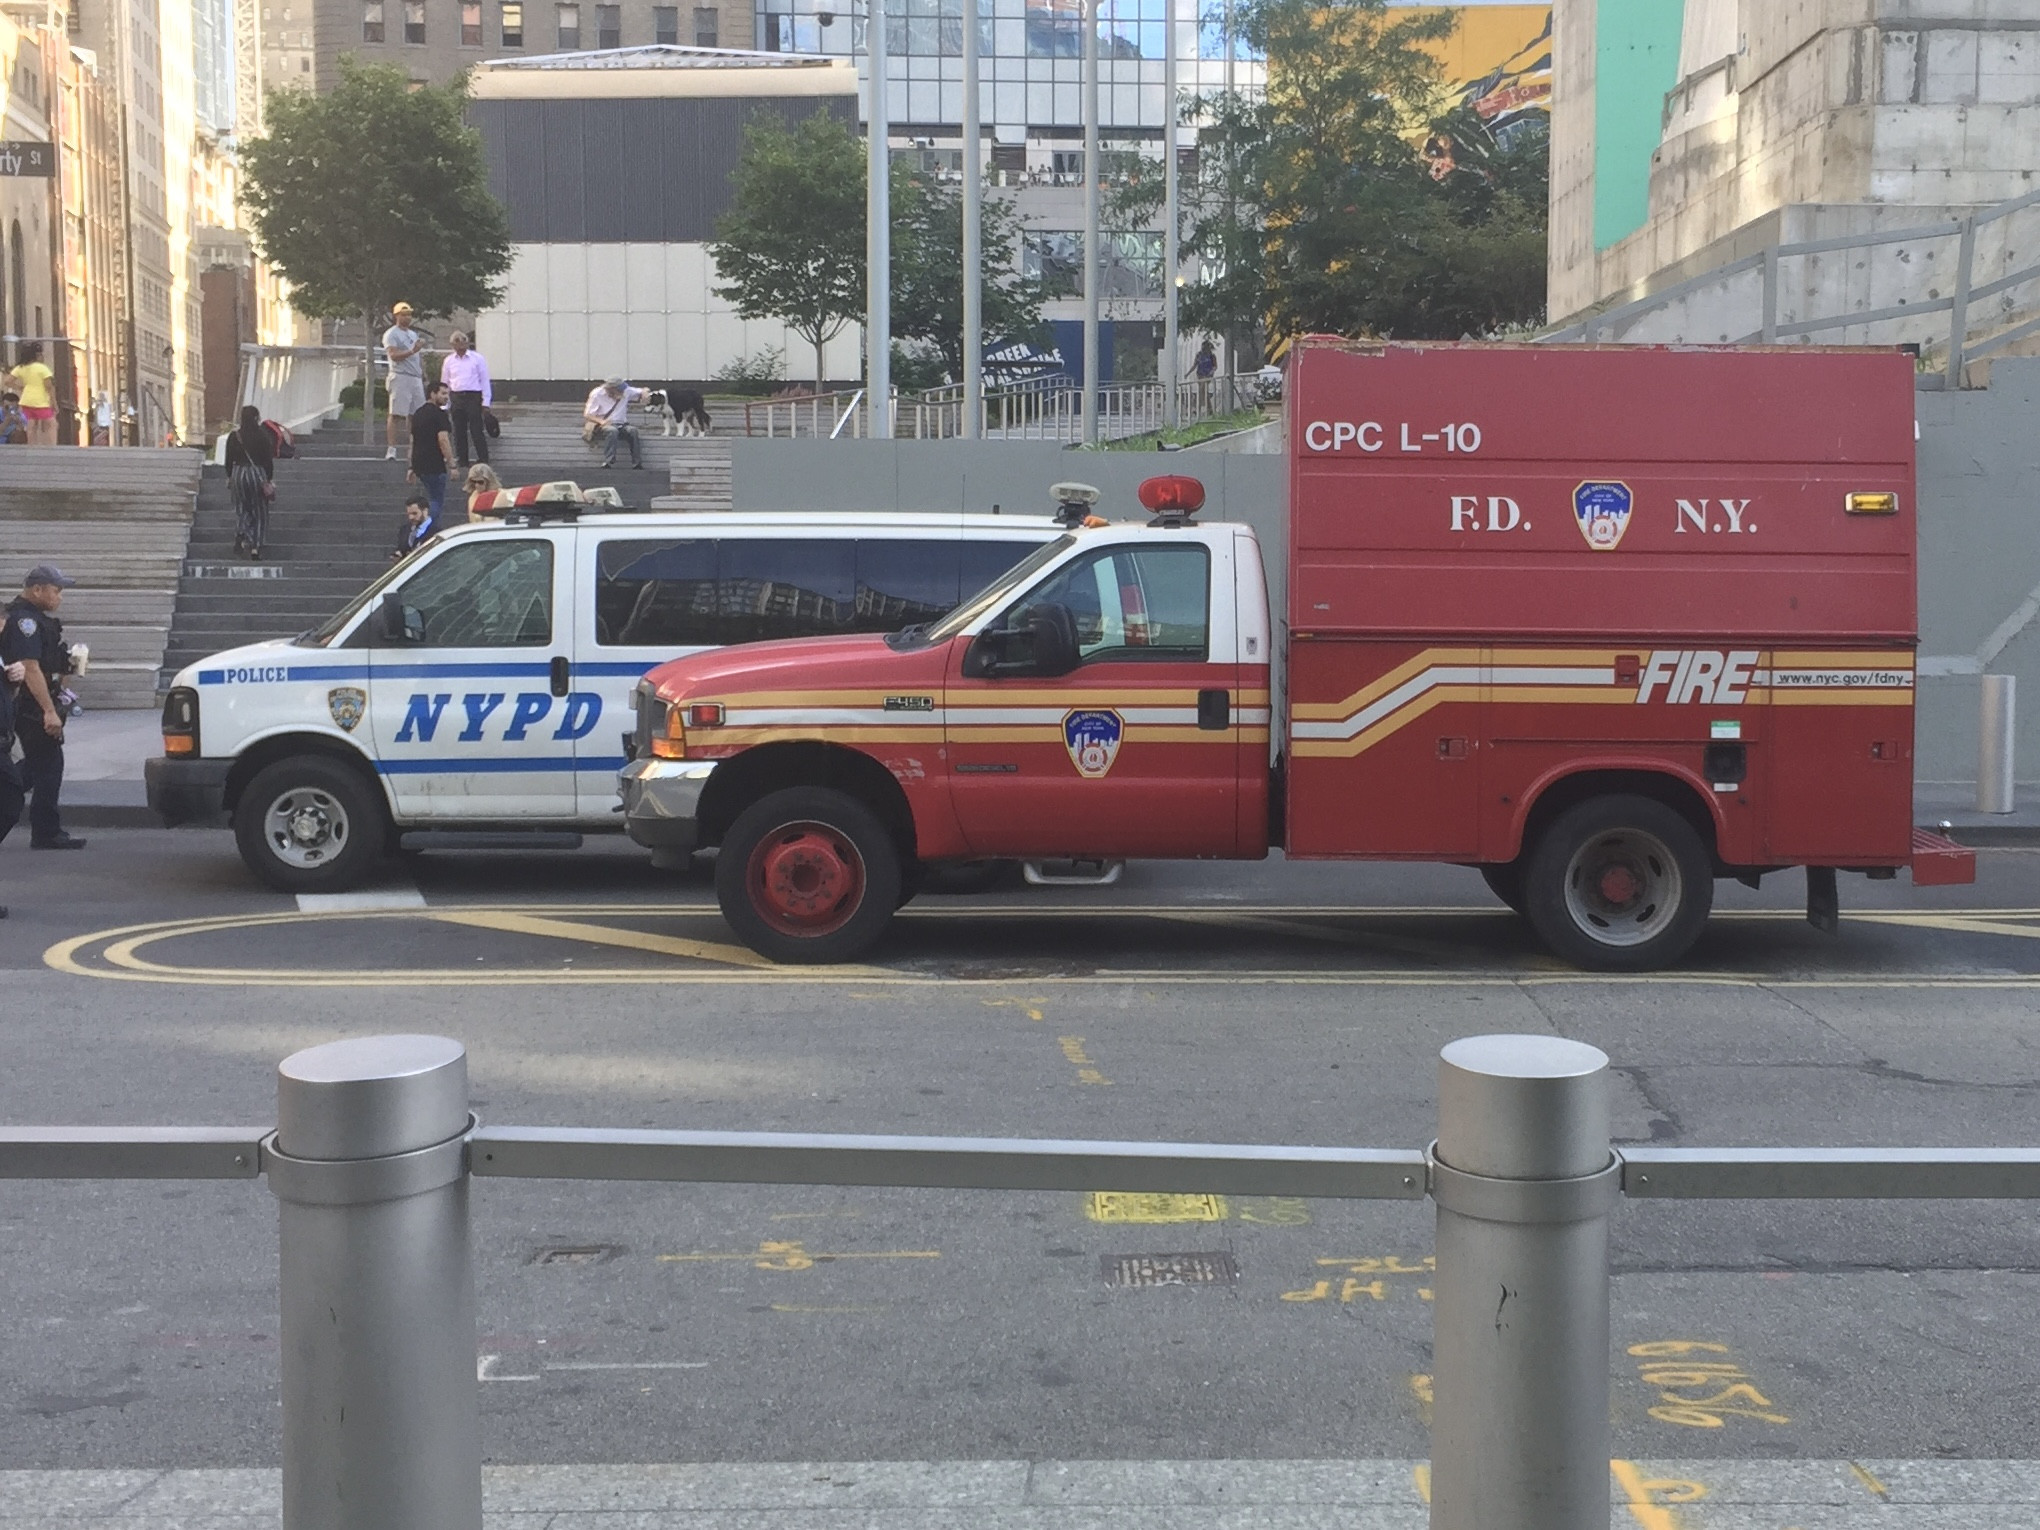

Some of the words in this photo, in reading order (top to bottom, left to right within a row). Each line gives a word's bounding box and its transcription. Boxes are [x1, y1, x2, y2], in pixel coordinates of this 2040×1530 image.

[0, 150, 22, 177] rty
[30, 150, 42, 165] St
[1305, 421, 1383, 452] CPC
[1401, 422, 1482, 453] L-10
[1450, 496, 1532, 532] F.D.
[1674, 499, 1758, 534] N.Y.
[226, 667, 286, 684] POLICE
[1634, 650, 1761, 704] FIRE
[1779, 672, 1904, 686] www.nyc.gov/fdny
[394, 692, 603, 743] NYPD
